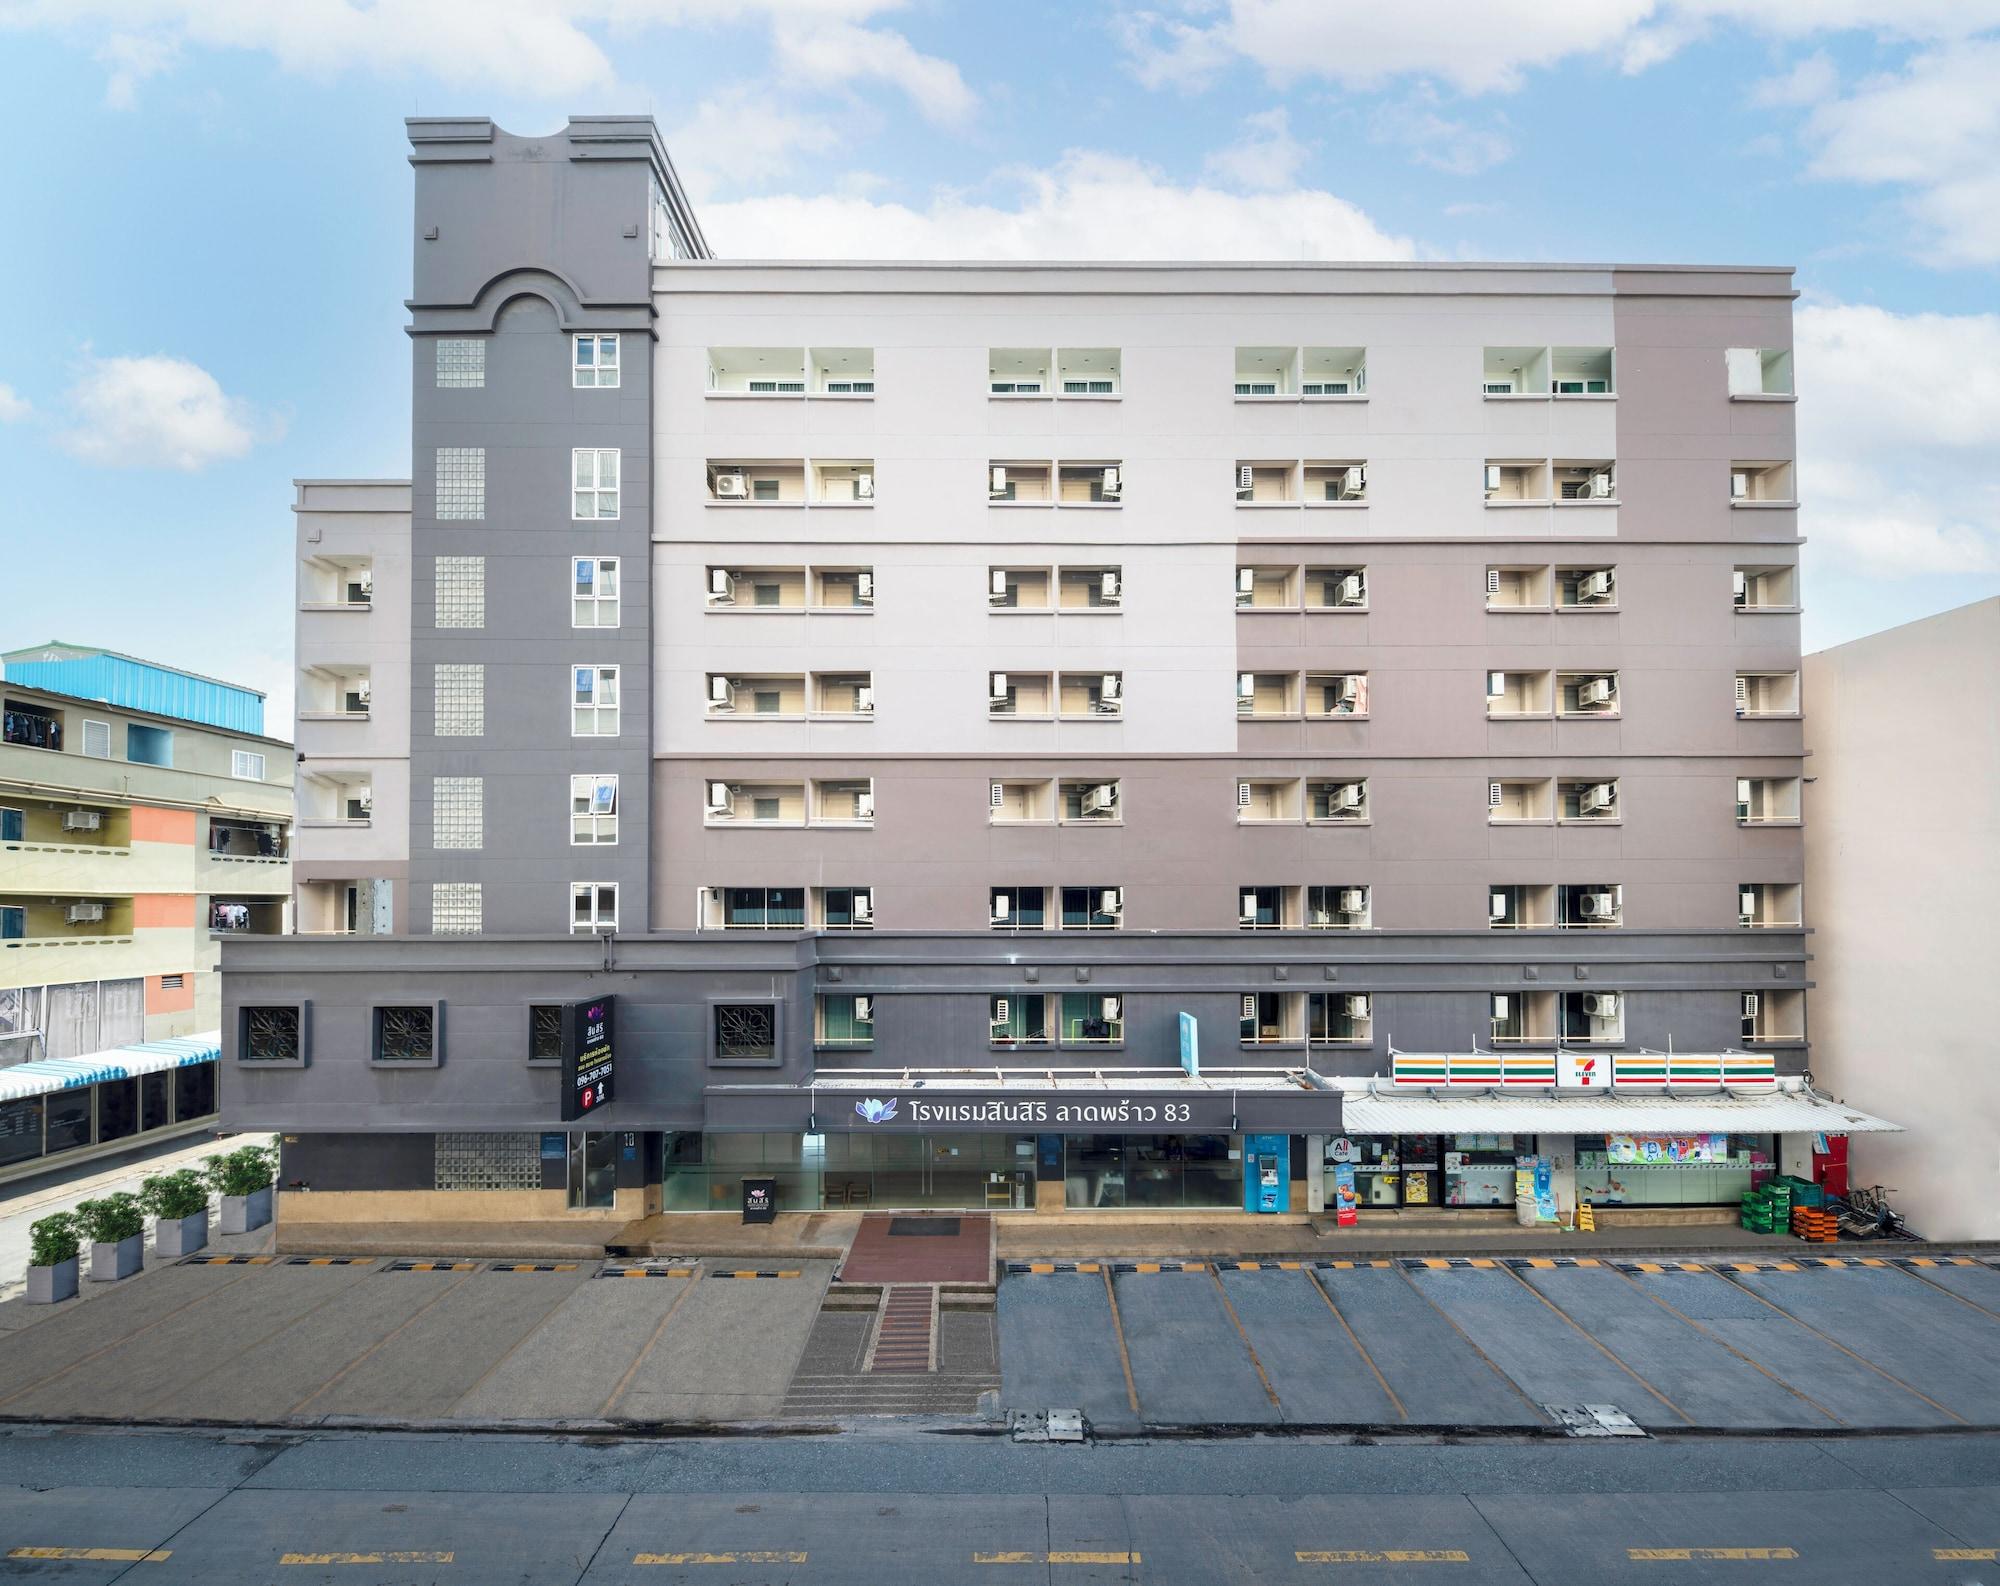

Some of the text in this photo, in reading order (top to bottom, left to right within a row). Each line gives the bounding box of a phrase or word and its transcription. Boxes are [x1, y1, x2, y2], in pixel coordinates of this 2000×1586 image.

[1576, 1059, 1595, 1085] 7
[585, 1091, 592, 1105] P
[908, 1100, 1191, 1122] โรงแรมสินสิริ ลาดพร้าว 83
